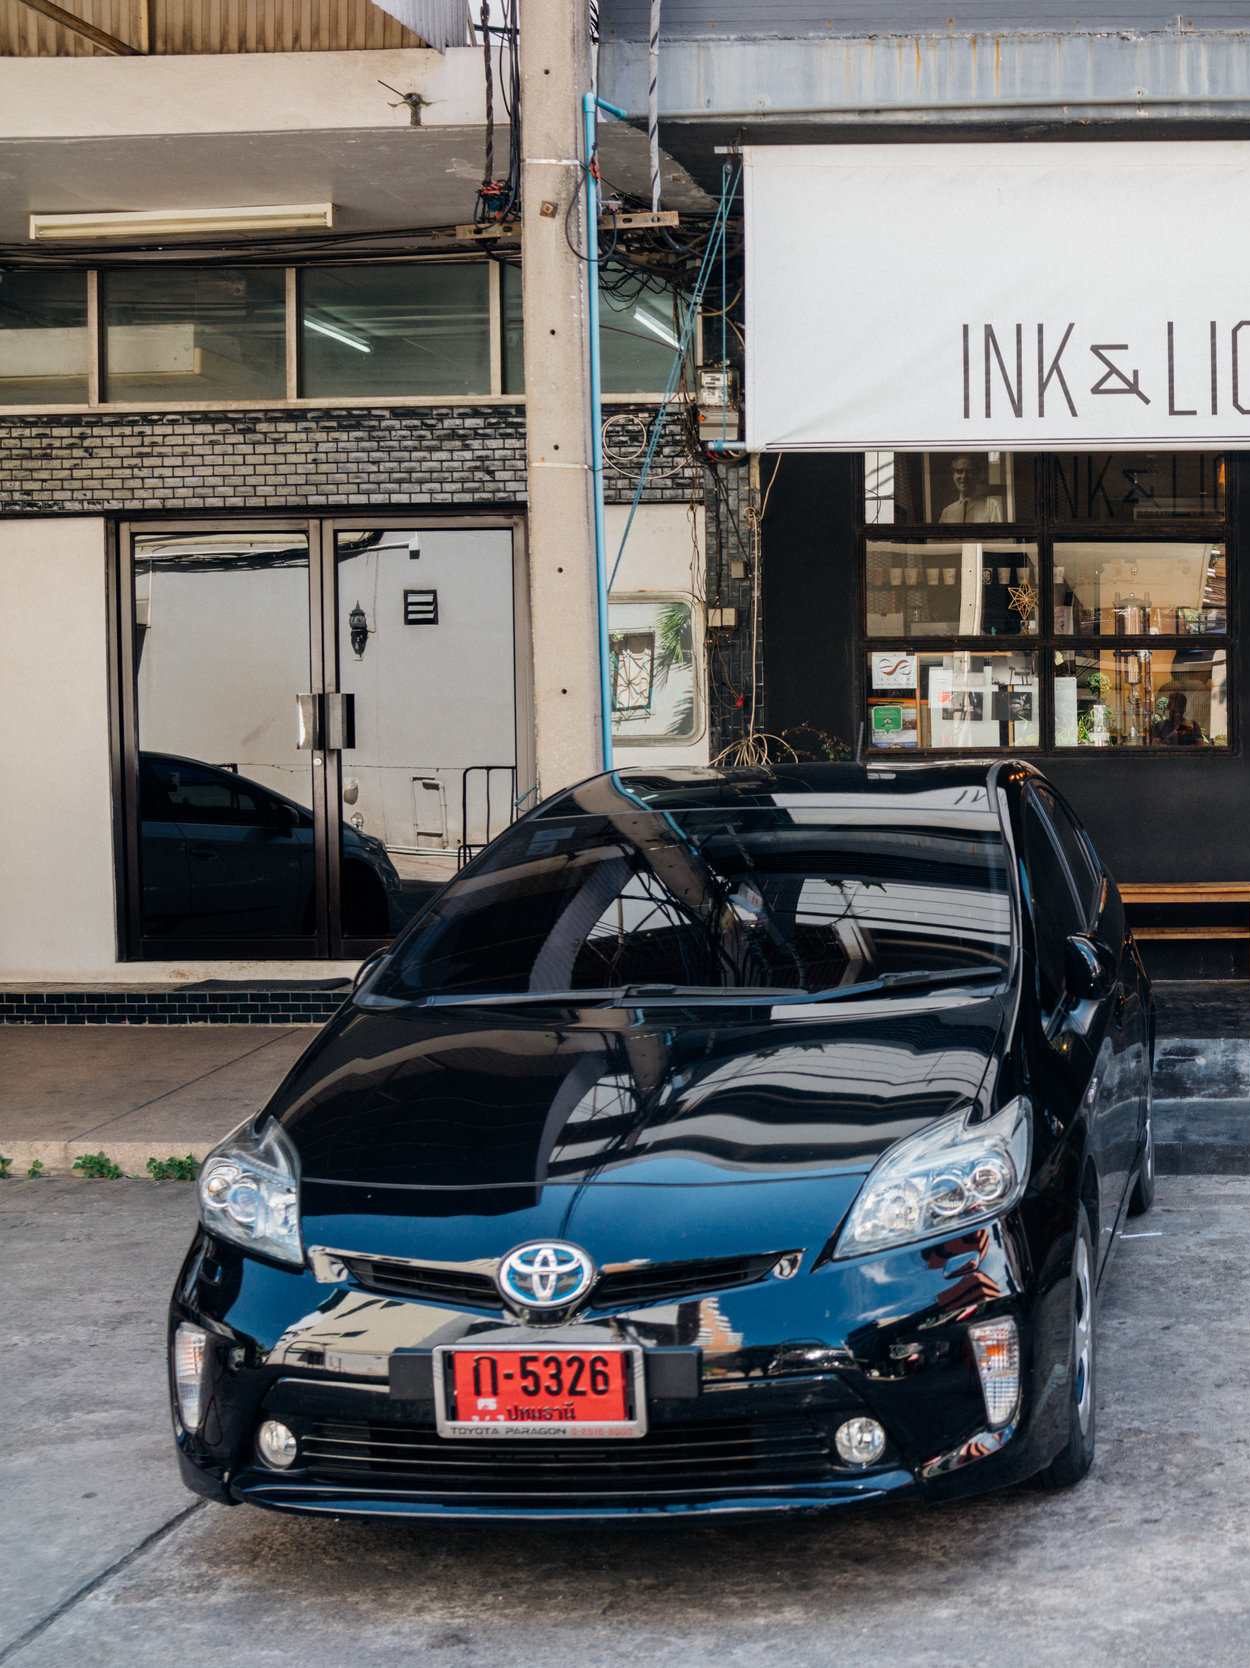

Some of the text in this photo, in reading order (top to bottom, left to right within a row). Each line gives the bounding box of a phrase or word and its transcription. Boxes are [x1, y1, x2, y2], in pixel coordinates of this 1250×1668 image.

[506, 1401, 577, 1421] ปทมธานี
[449, 1426, 500, 1436] TOYOTA
[505, 1426, 567, 1436] PARAGON
